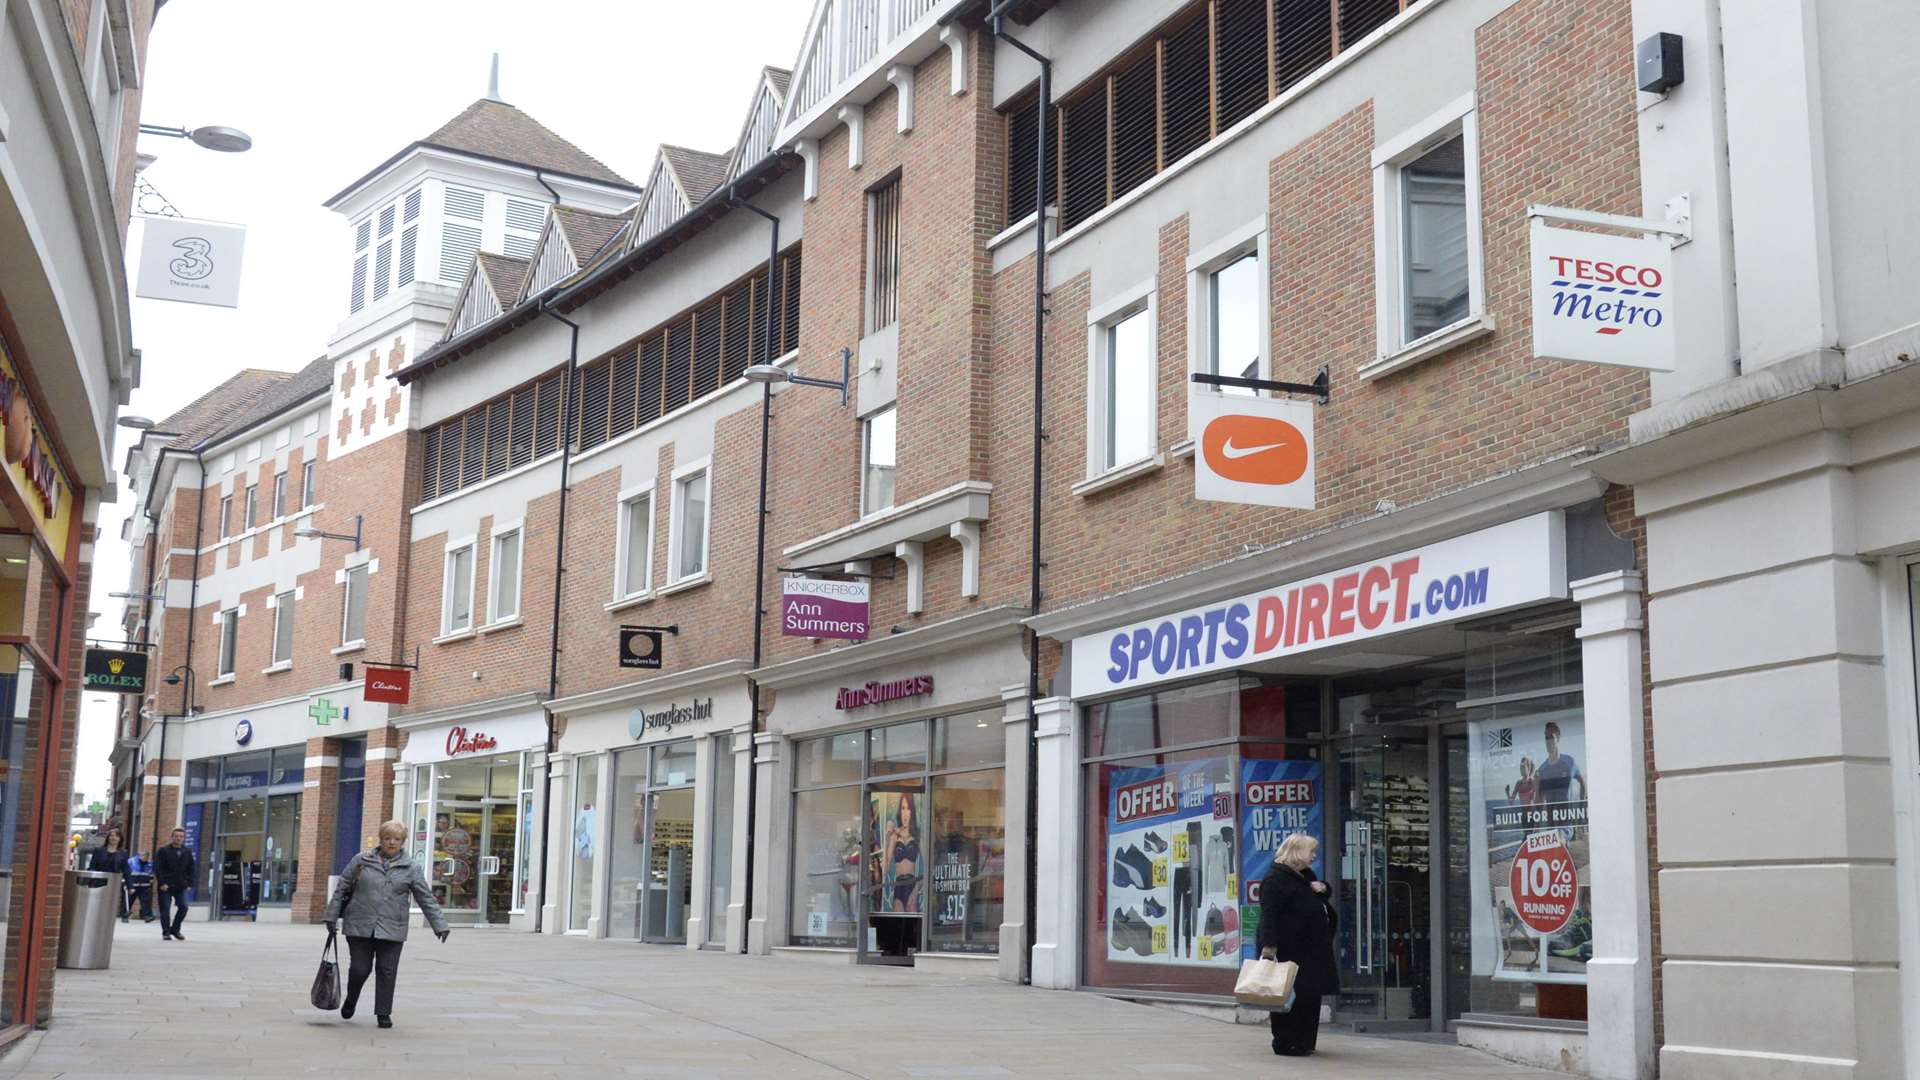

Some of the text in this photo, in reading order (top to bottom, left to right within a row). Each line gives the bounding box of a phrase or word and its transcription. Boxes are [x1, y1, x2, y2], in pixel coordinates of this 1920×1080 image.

[1549, 256, 1662, 288] TESCO
[787, 581, 865, 596] KNICKERBOX
[786, 601, 822, 615] Ann
[786, 615, 865, 633] Summers
[88, 673, 142, 687] ROLEX
[836, 676, 933, 710] Ann Summers
[646, 698, 712, 732] sunglass hut
[1118, 781, 1175, 818] OFFER
[1248, 783, 1311, 803] OFFER
[1252, 807, 1308, 829] OF THE
[1496, 813, 1522, 825] BUILT
[1527, 810, 1548, 823] FOR
[1530, 833, 1558, 849] EXTRA
[947, 852, 959, 864] THE
[935, 863, 971, 880] ULTIMATE
[1515, 858, 1571, 897] 10%
[1550, 884, 1572, 898] OFF
[946, 895, 966, 921] £15
[1523, 902, 1566, 915] RUNNING
